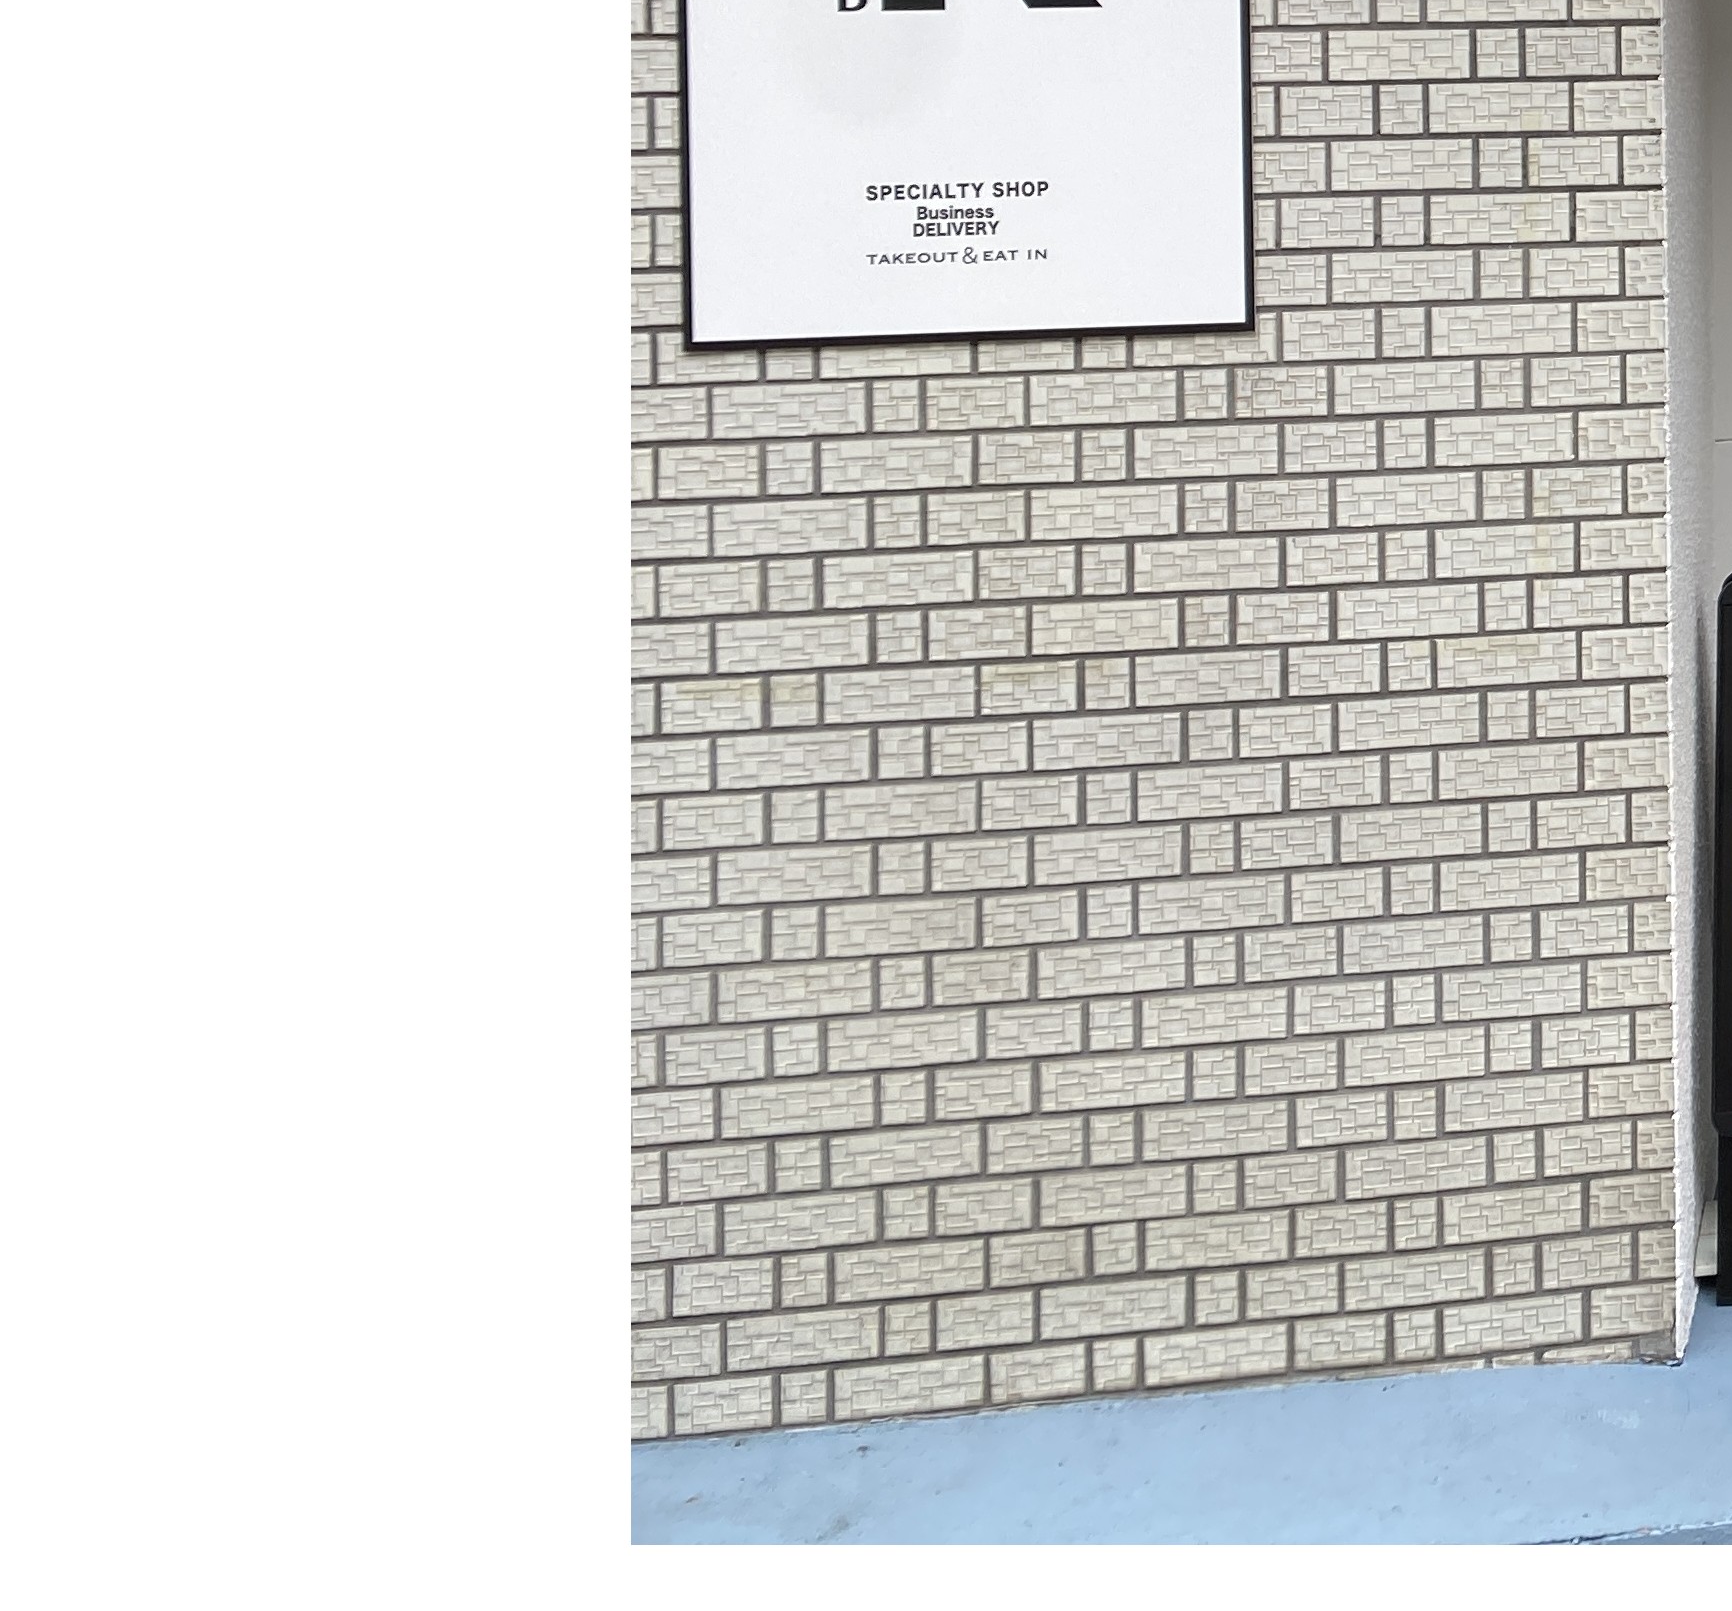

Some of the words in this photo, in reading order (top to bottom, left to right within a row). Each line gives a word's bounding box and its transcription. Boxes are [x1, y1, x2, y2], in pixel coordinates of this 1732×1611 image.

[866, 182, 985, 201] SPECIALTY
[992, 181, 1050, 197] SHOP
[916, 206, 995, 219] Business
[912, 221, 999, 237] DELIVERY
[866, 253, 958, 265] TAKEOUT
[983, 249, 1019, 261] EAT
[1027, 248, 1048, 260] IN
